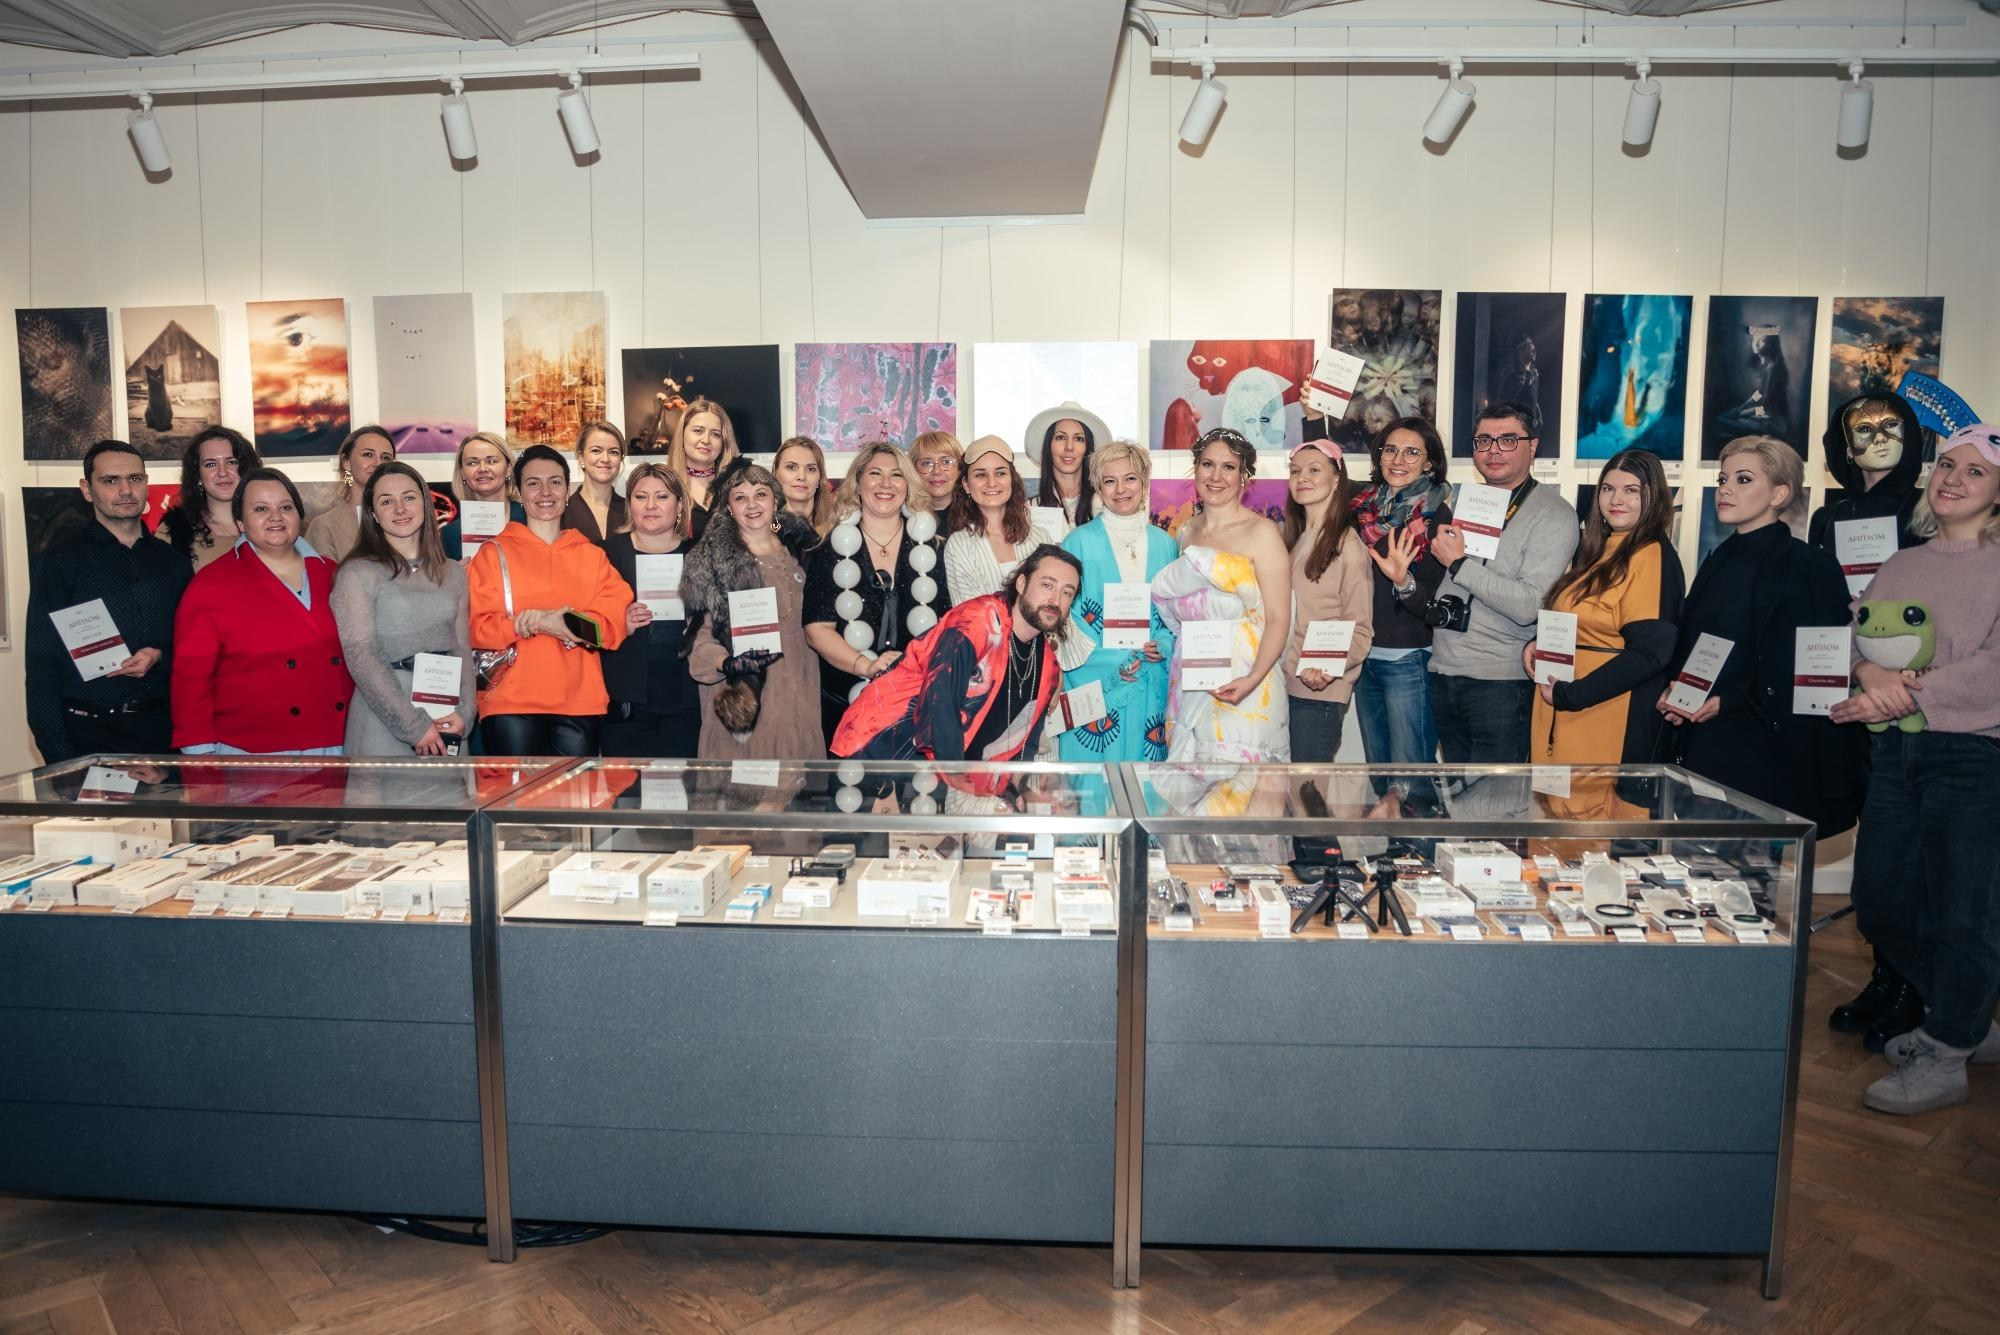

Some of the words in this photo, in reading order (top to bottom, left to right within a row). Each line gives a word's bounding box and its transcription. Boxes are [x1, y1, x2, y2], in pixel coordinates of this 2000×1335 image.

[1847, 534, 1886, 543] ДИПЛОМ
[68, 615, 101, 629] ДИПЛОМ
[1806, 644, 1840, 652] ДИПЛОМ
